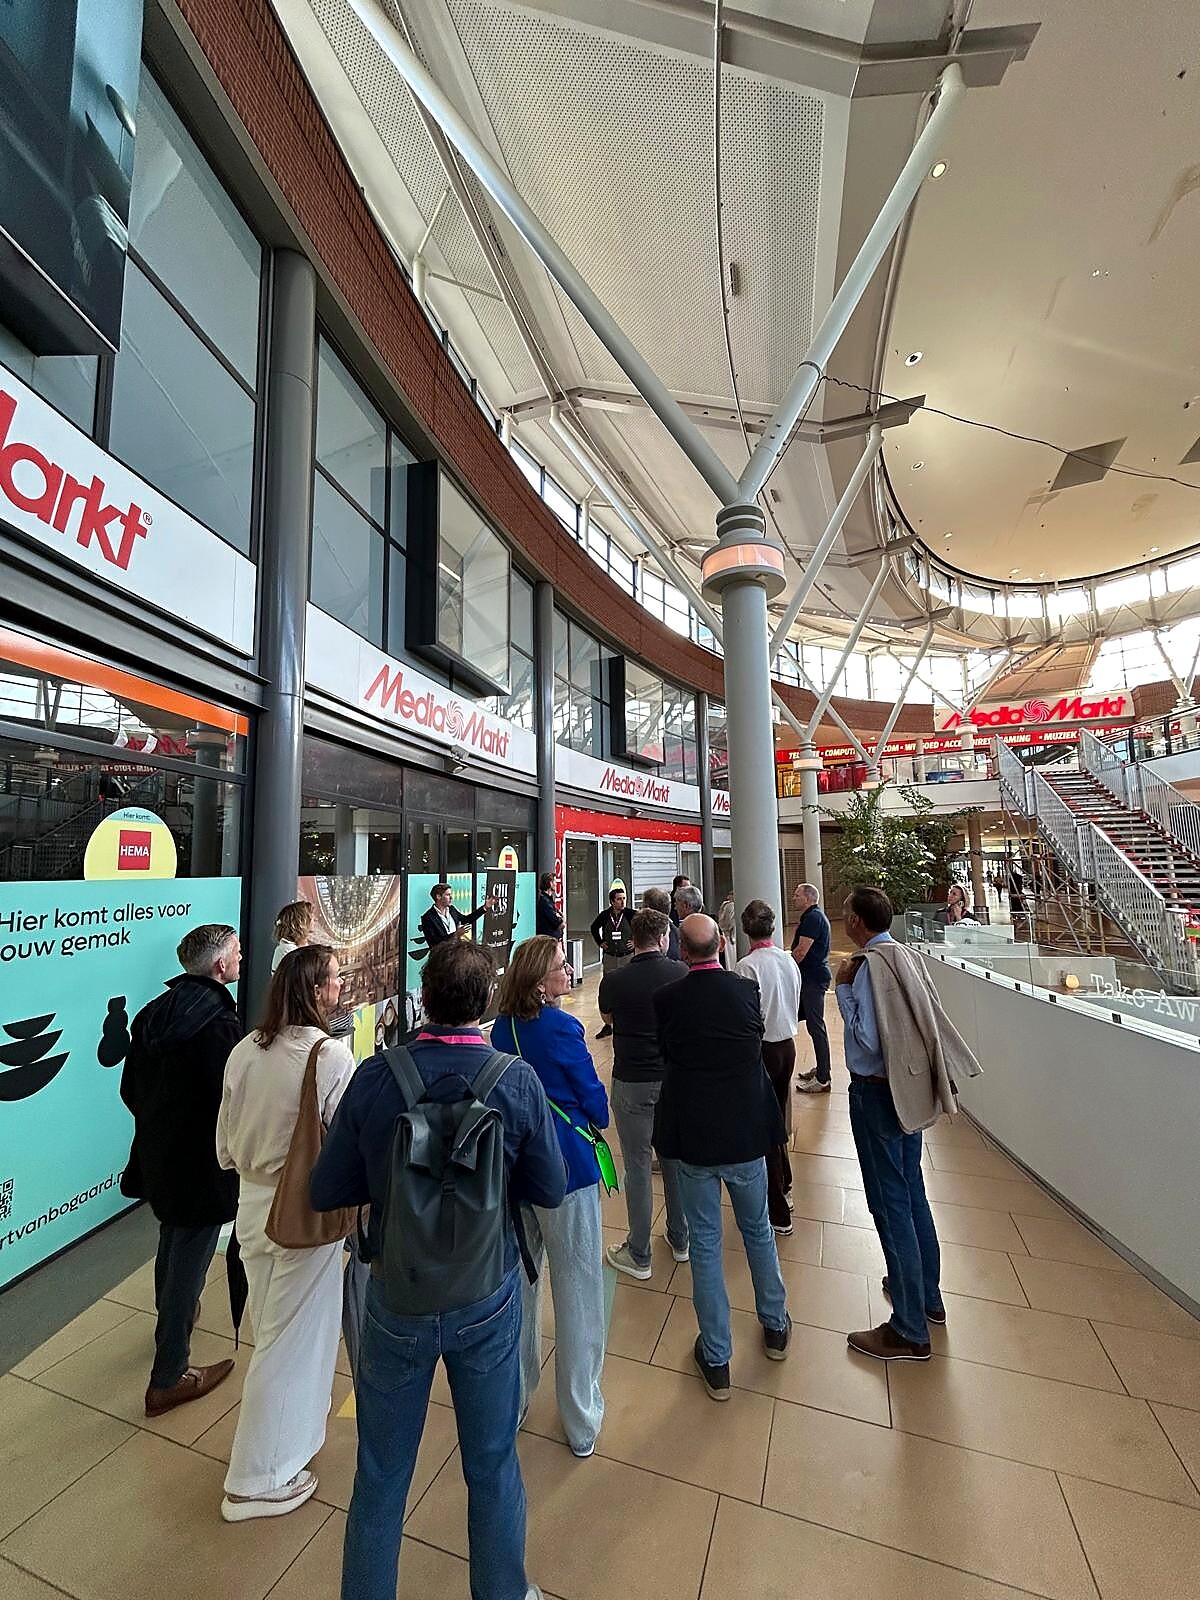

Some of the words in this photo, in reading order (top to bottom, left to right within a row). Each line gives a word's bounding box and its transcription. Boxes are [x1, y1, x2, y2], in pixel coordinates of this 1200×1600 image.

[364, 664, 446, 733] Media
[461, 711, 509, 758] Markt
[1046, 697, 1126, 721] Markt
[1043, 731, 1078, 741] MUZIEK
[599, 767, 635, 795] Media
[642, 778, 669, 803] Markt
[120, 845, 150, 857] HEMA
[0, 910, 48, 932] Hier
[54, 907, 108, 928] komt
[113, 902, 154, 922] alles
[158, 902, 192, 917] voor
[61, 927, 131, 956] gemak
